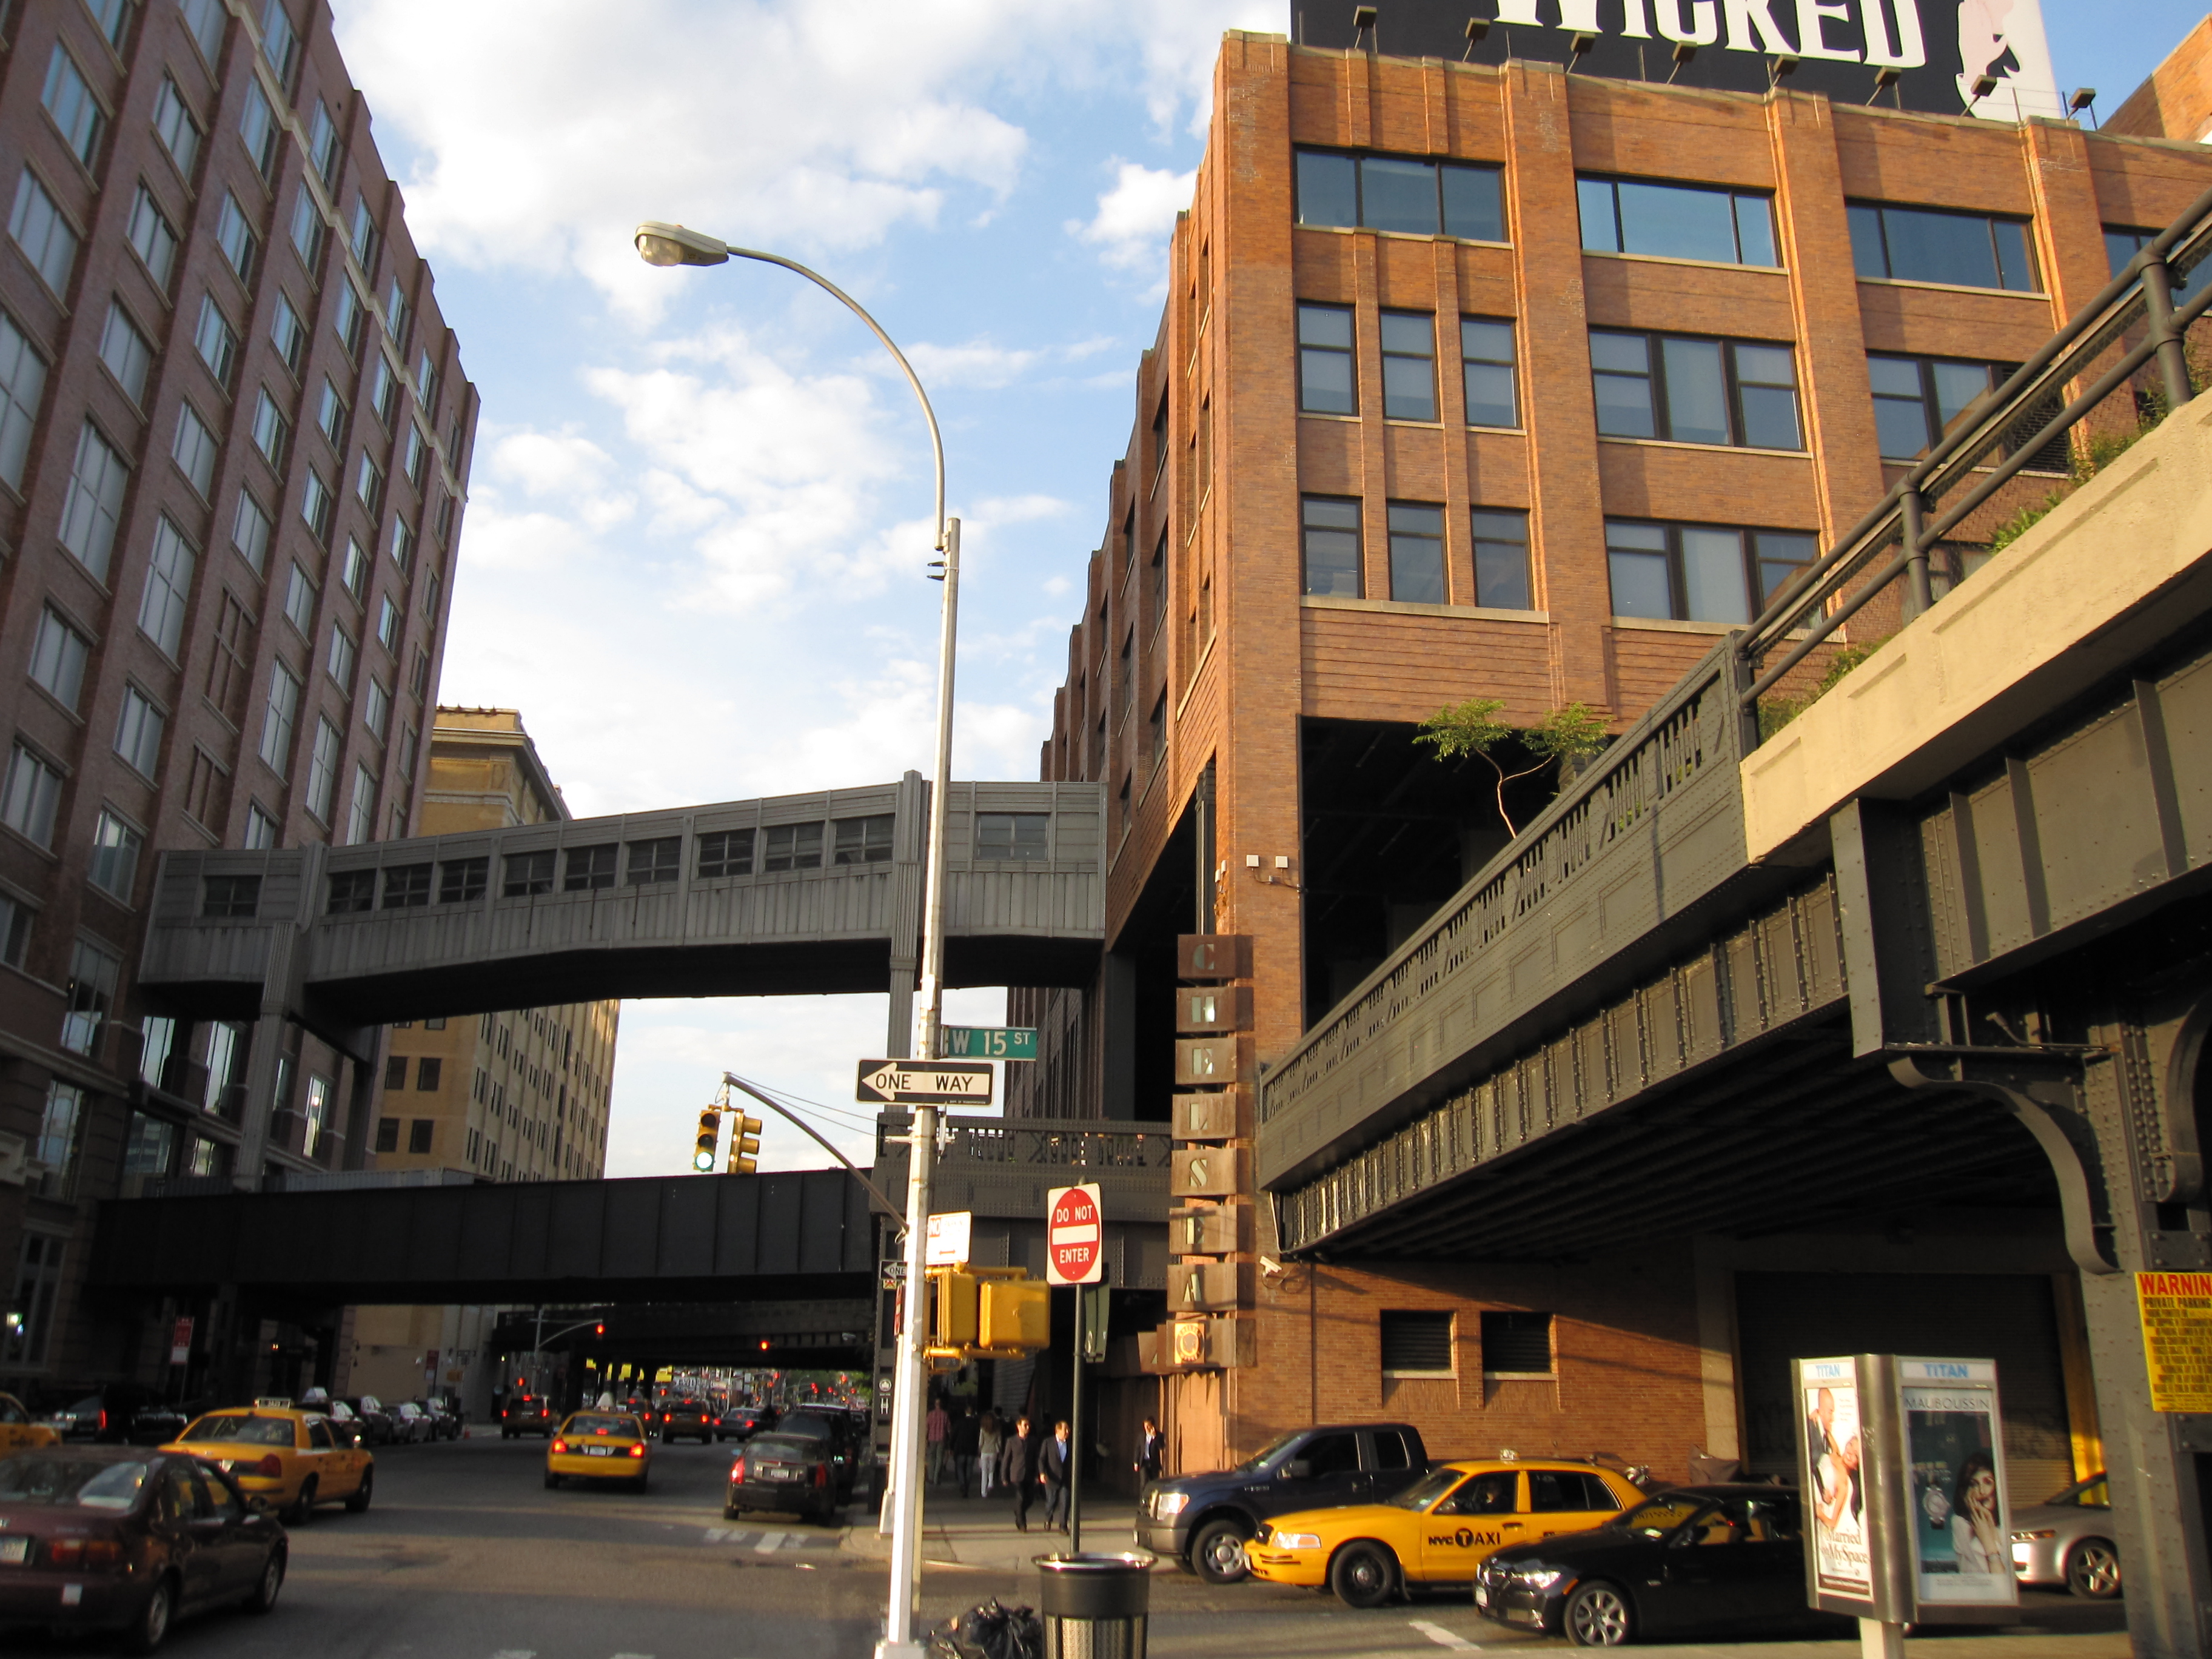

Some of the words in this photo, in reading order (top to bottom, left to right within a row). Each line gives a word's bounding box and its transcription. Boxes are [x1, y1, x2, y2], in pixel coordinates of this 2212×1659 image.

[952, 1030, 970, 1054] W
[984, 1031, 1007, 1056] 15
[1014, 1032, 1031, 1045] ST
[876, 1073, 911, 1090] ONE
[936, 1074, 973, 1092] WAY
[1184, 943, 1215, 1302] CHELSEA
[1056, 1207, 1070, 1222] DO
[1074, 1205, 1092, 1221] NOT
[930, 1219, 941, 1236] NO
[1059, 1247, 1090, 1264] ENTER
[890, 1267, 906, 1275] ONE
[1815, 1364, 1841, 1378] TITAN
[1923, 1364, 1968, 1378] TITAN
[1904, 1396, 1990, 1410] MAUBOUSSIN
[1428, 1536, 1454, 1546] NYC
[1455, 1527, 1501, 1547] TAXI
